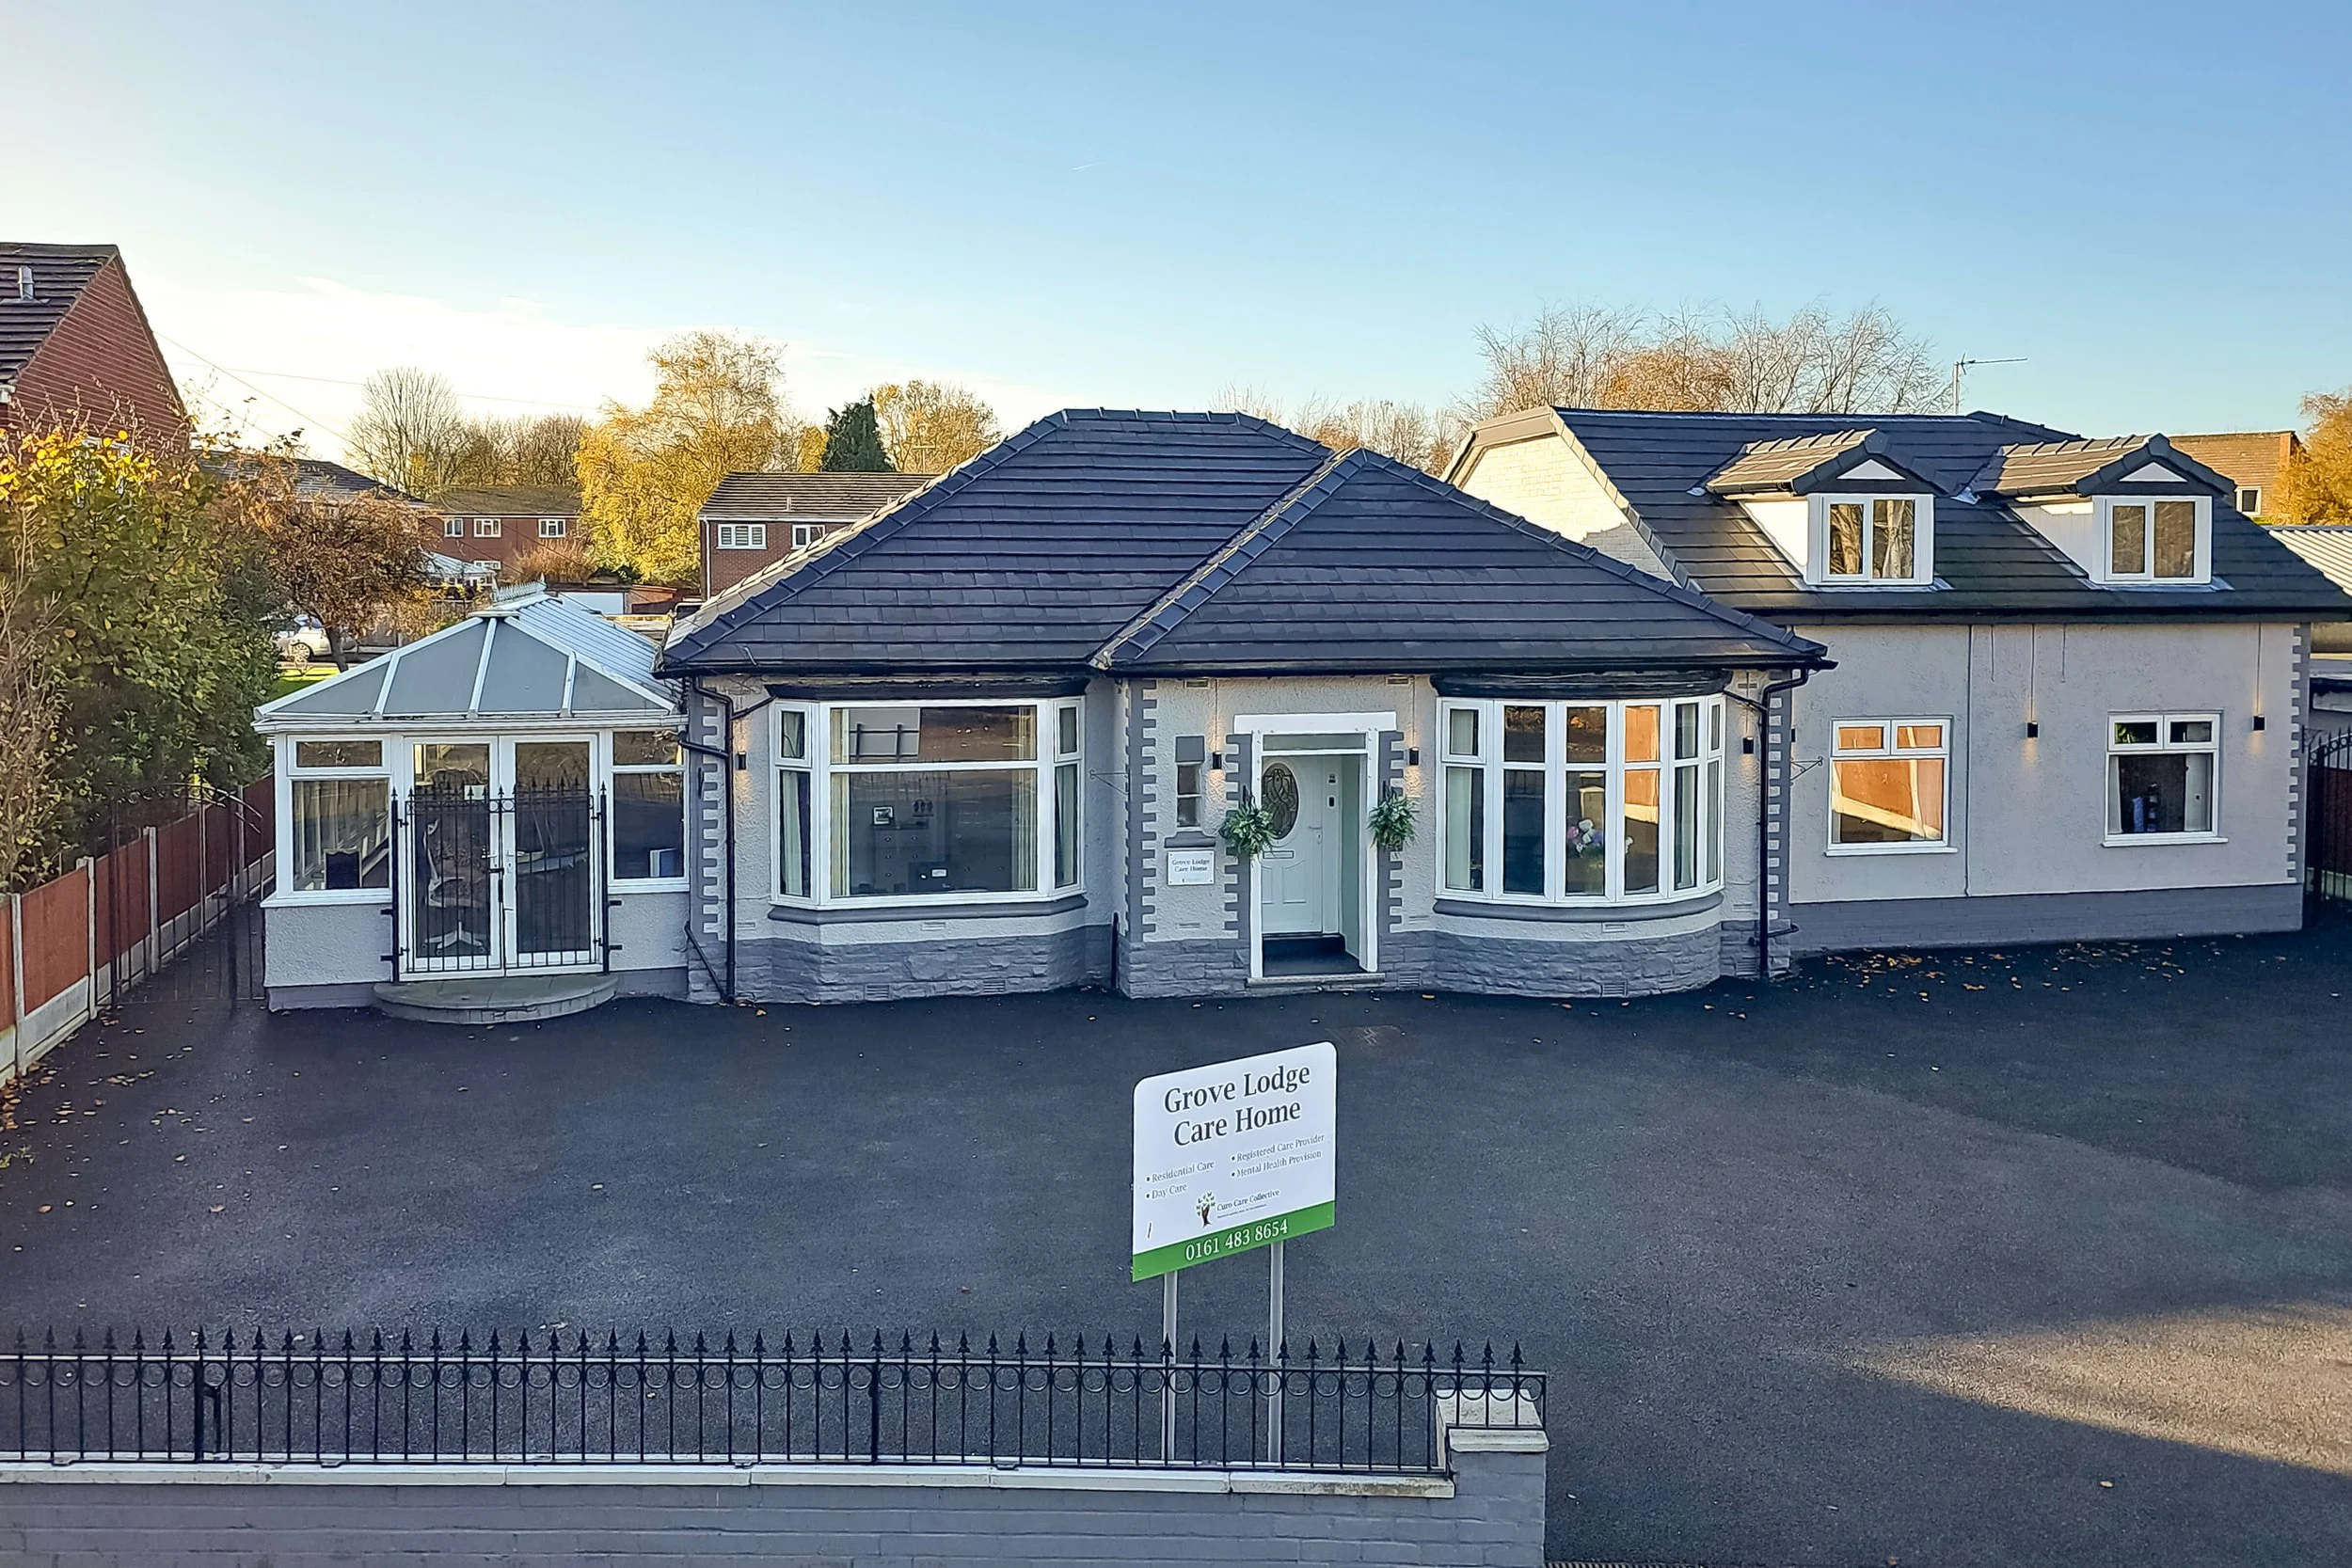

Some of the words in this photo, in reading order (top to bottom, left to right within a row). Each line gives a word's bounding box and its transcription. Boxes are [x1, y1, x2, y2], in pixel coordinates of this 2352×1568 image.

[1165, 1082, 1235, 1113] Grove
[1244, 1066, 1311, 1096] Lodge
[1174, 1117, 1227, 1147] Care
[1235, 1101, 1301, 1133] Home
[1236, 1145, 1276, 1162] Registered
[1277, 1141, 1294, 1152] Care
[1295, 1134, 1325, 1148] Provider
[1152, 1164, 1195, 1182] Residential
[1197, 1161, 1215, 1171] Care
[1236, 1163, 1262, 1178] Mental
[1263, 1157, 1287, 1171] Health
[1289, 1150, 1322, 1164] Provision
[1152, 1189, 1168, 1199] Day
[1169, 1184, 1187, 1195] Care
[1233, 1198, 1248, 1207] Care
[1249, 1190, 1279, 1203] Collective
[1185, 1237, 1220, 1260] 0161
[1225, 1228, 1250, 1249] 483
[1255, 1219, 1288, 1241] 8654
